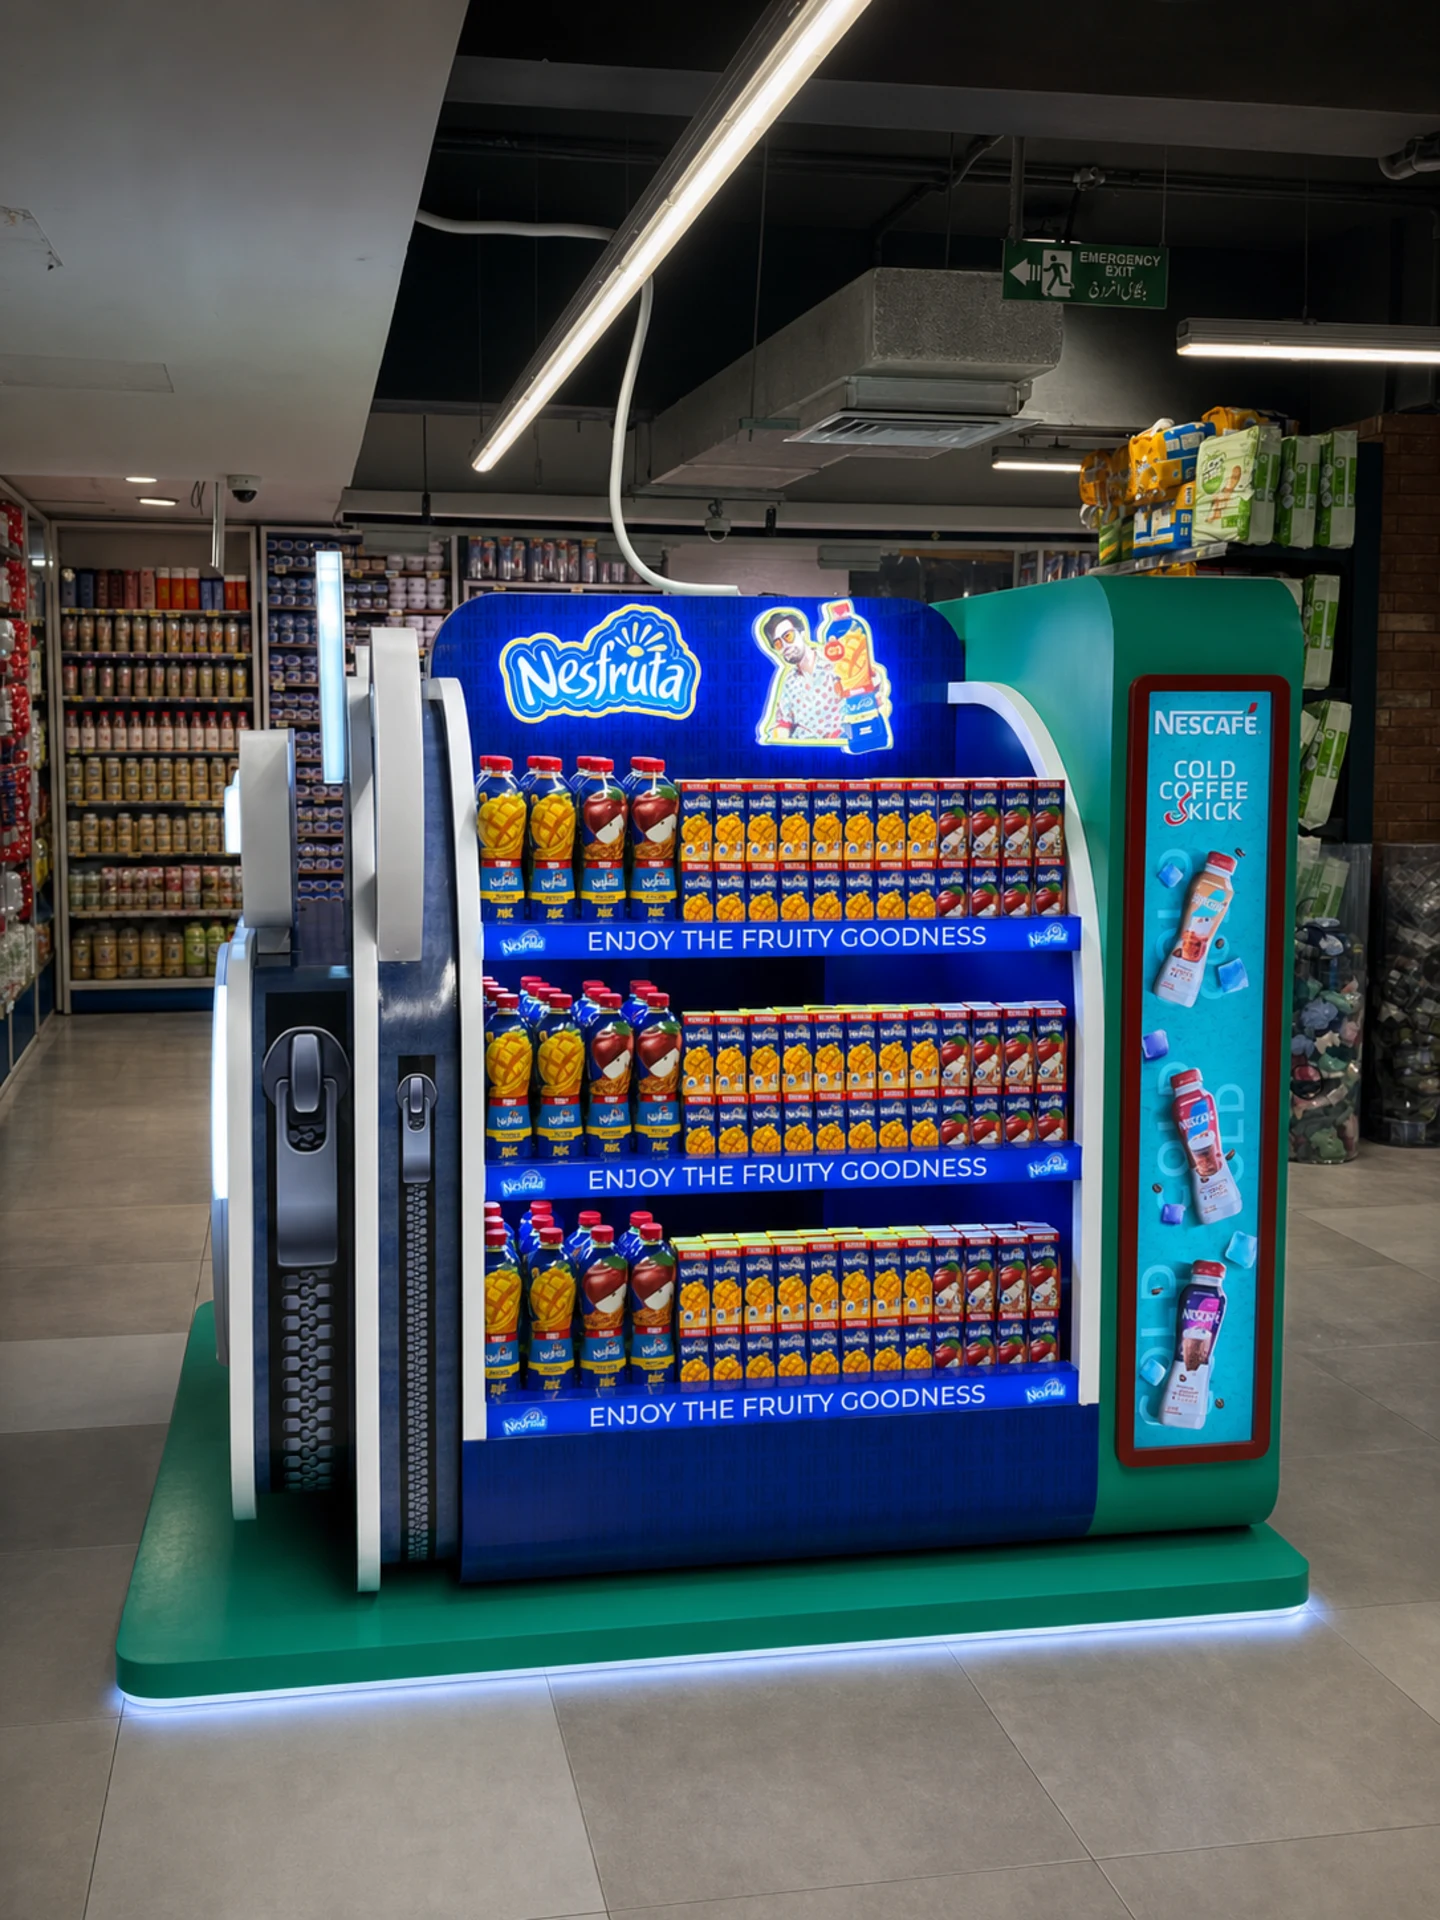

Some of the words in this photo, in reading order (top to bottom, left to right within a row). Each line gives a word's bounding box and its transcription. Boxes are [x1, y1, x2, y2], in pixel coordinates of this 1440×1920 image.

[1080, 251, 1161, 267] EMERGENCY
[1105, 265, 1135, 277] EXIT
[516, 640, 685, 706] Nesfruta
[1174, 760, 1236, 779] COLD
[1159, 781, 1249, 800] COFFEE
[588, 930, 675, 951] ENJOY
[681, 930, 733, 950] THE
[743, 928, 834, 949] FRUITY
[841, 926, 987, 948] GOODNESS
[589, 1167, 676, 1190] ENJOY
[682, 1165, 733, 1186] THE
[743, 1162, 834, 1185] FRUITY
[841, 1157, 988, 1181] GOODNESS
[590, 1402, 676, 1427] ENJOY
[682, 1399, 734, 1421] THE
[743, 1393, 834, 1417] FRUITY
[841, 1385, 986, 1411] GOODNESS
